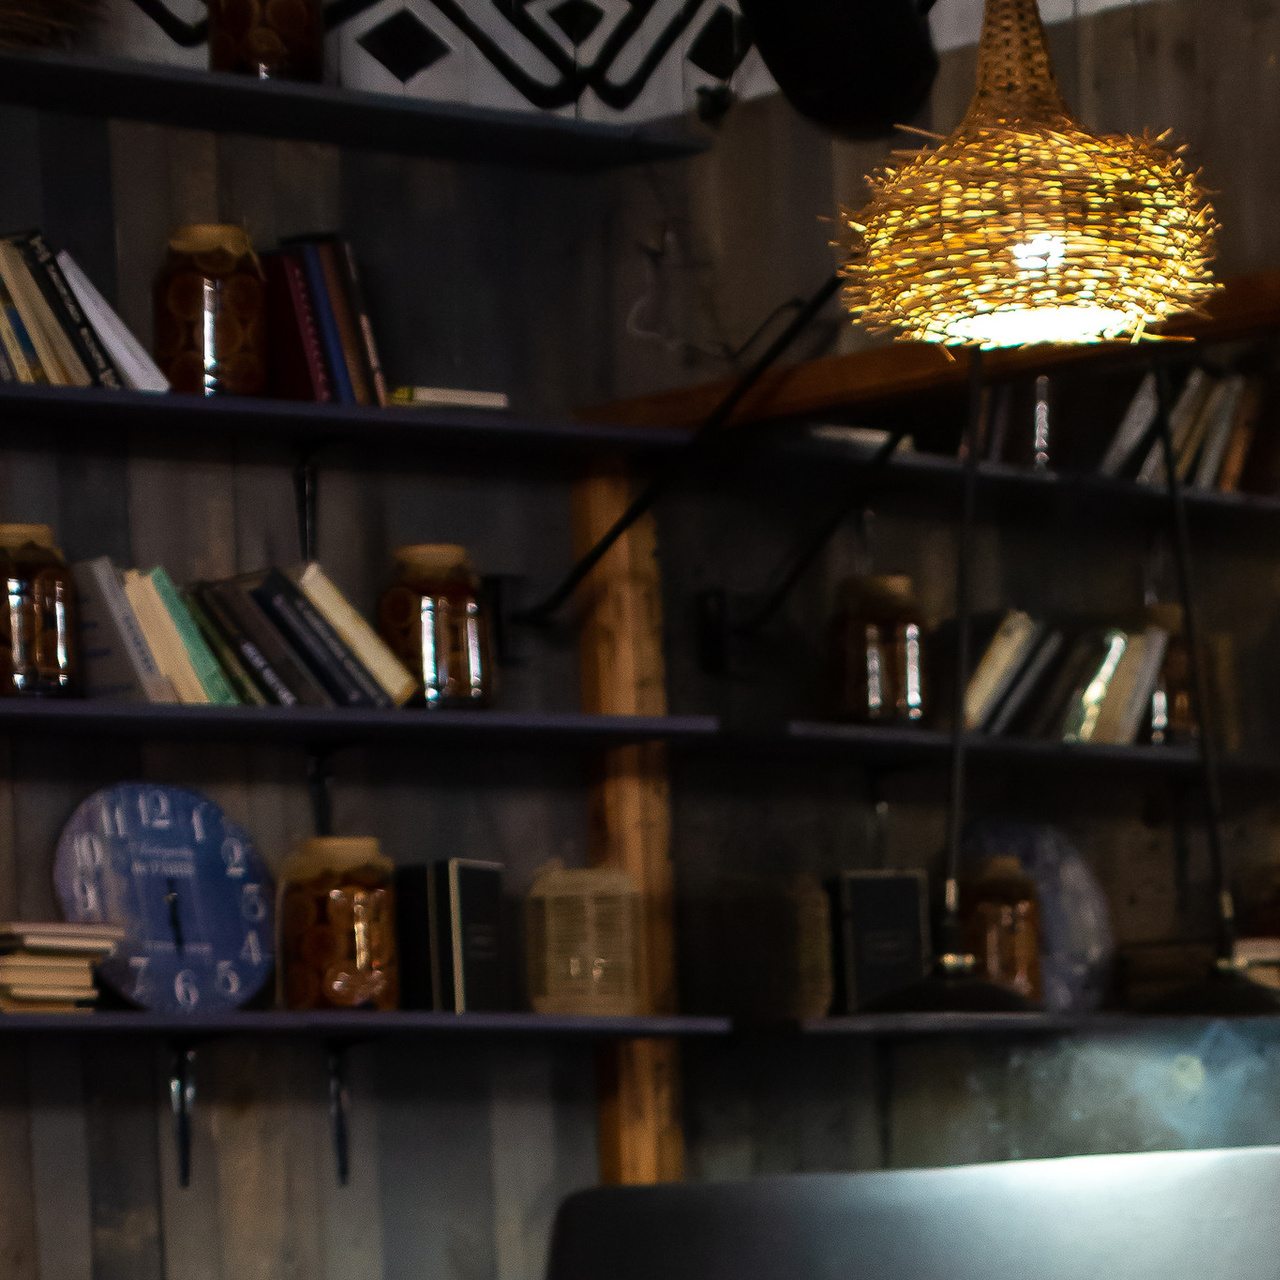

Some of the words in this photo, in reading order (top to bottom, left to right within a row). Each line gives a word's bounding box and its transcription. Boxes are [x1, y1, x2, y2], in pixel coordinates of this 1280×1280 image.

[138, 790, 171, 829] 12
[220, 836, 246, 877] 2
[174, 968, 200, 1007] 6
